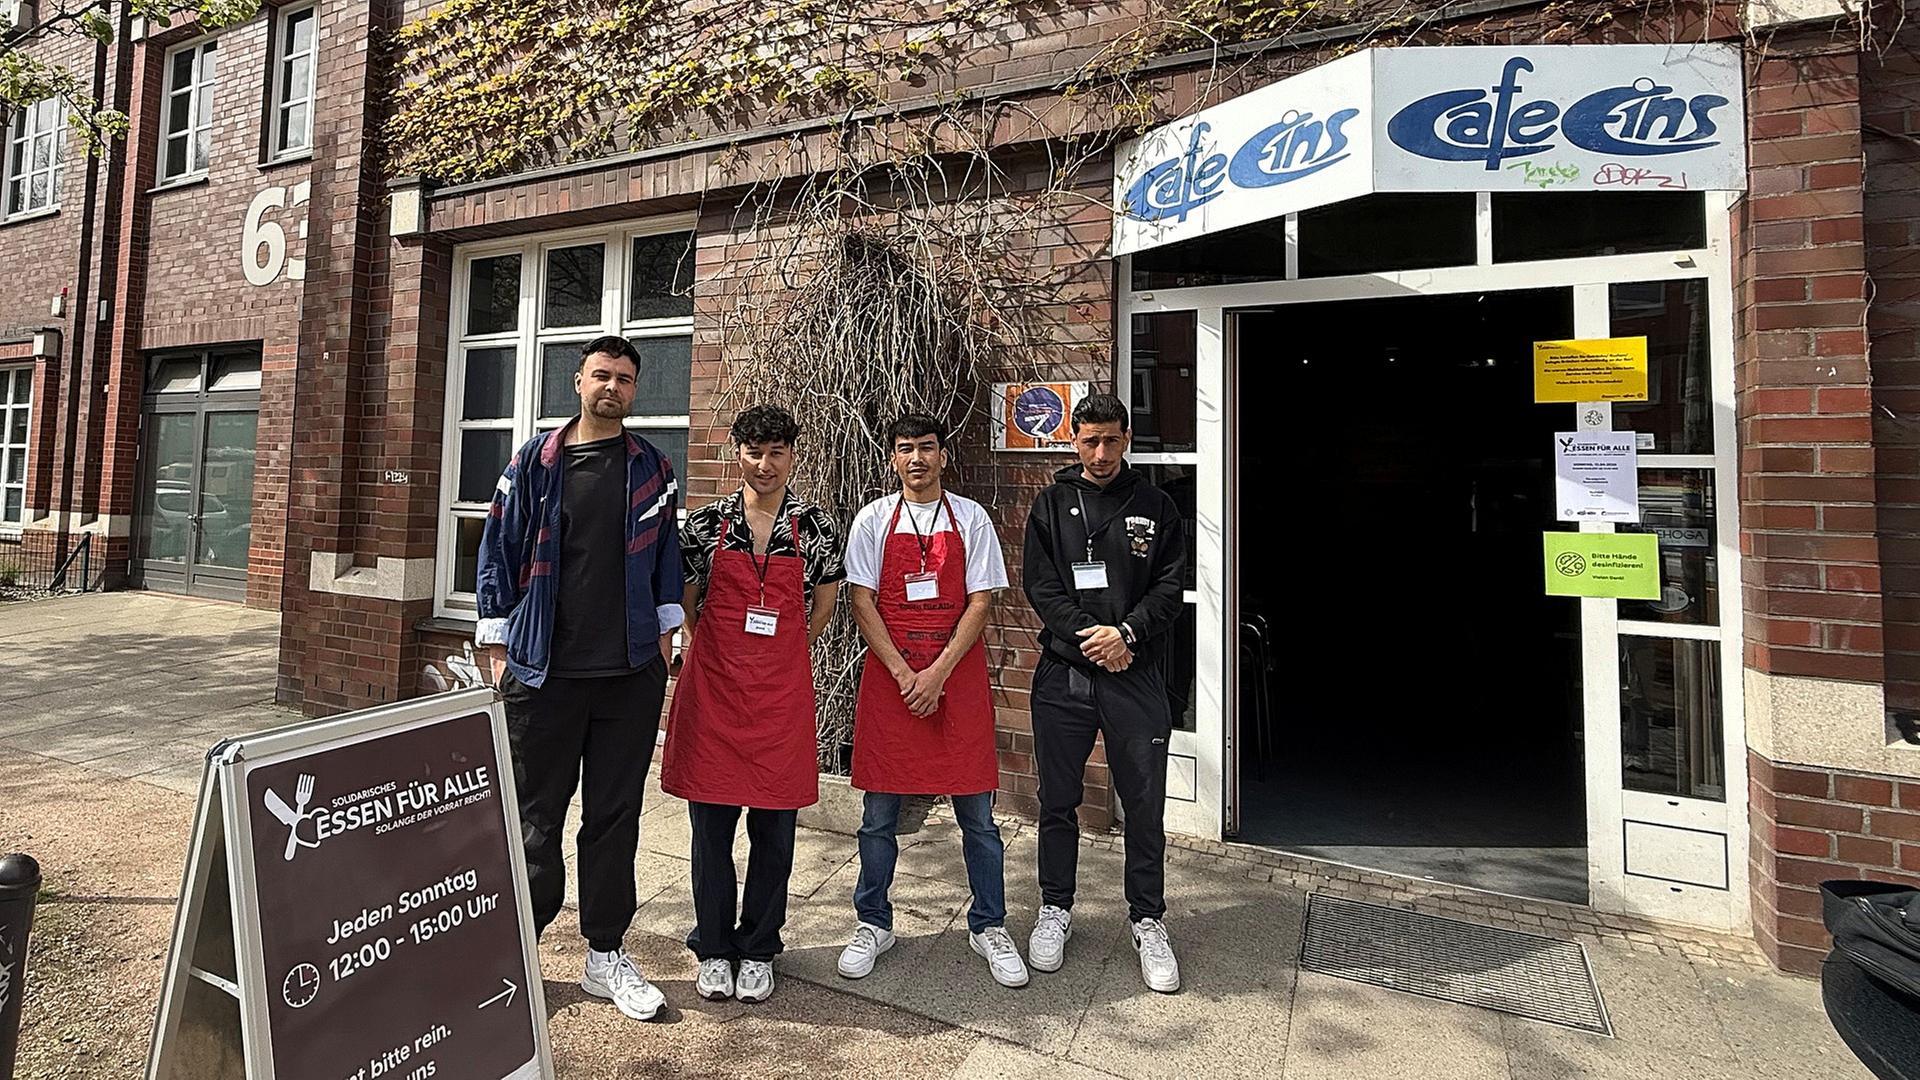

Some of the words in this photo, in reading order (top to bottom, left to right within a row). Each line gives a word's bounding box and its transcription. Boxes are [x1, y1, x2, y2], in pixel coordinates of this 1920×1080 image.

[1387, 56, 1560, 171] Cafe
[1560, 77, 1730, 156] Eins
[1124, 121, 1227, 223] Cafe
[1228, 109, 1360, 188] Eins
[1597, 443, 1611, 451] FÜR
[1612, 552, 1637, 560] Hände
[1648, 529, 1705, 541] EHOGA
[1591, 561, 1644, 569] desinfizieren!
[317, 796, 393, 840] ESSEN
[396, 781, 440, 815] FÜR
[444, 766, 490, 800] ALLE
[332, 781, 397, 808] SOLIDARISCHES
[375, 813, 416, 835] SOLANGE
[416, 809, 433, 822] DER
[433, 798, 464, 817] VORRAT
[464, 789, 492, 806] REICHT!
[327, 904, 393, 945] Jeden
[398, 869, 478, 914] Sonntag
[328, 937, 391, 982] 12:00
[409, 904, 463, 945] 15:00
[466, 893, 499, 919] Uhr
[370, 1045, 411, 1079] bitte
[414, 1024, 452, 1054] rein.
